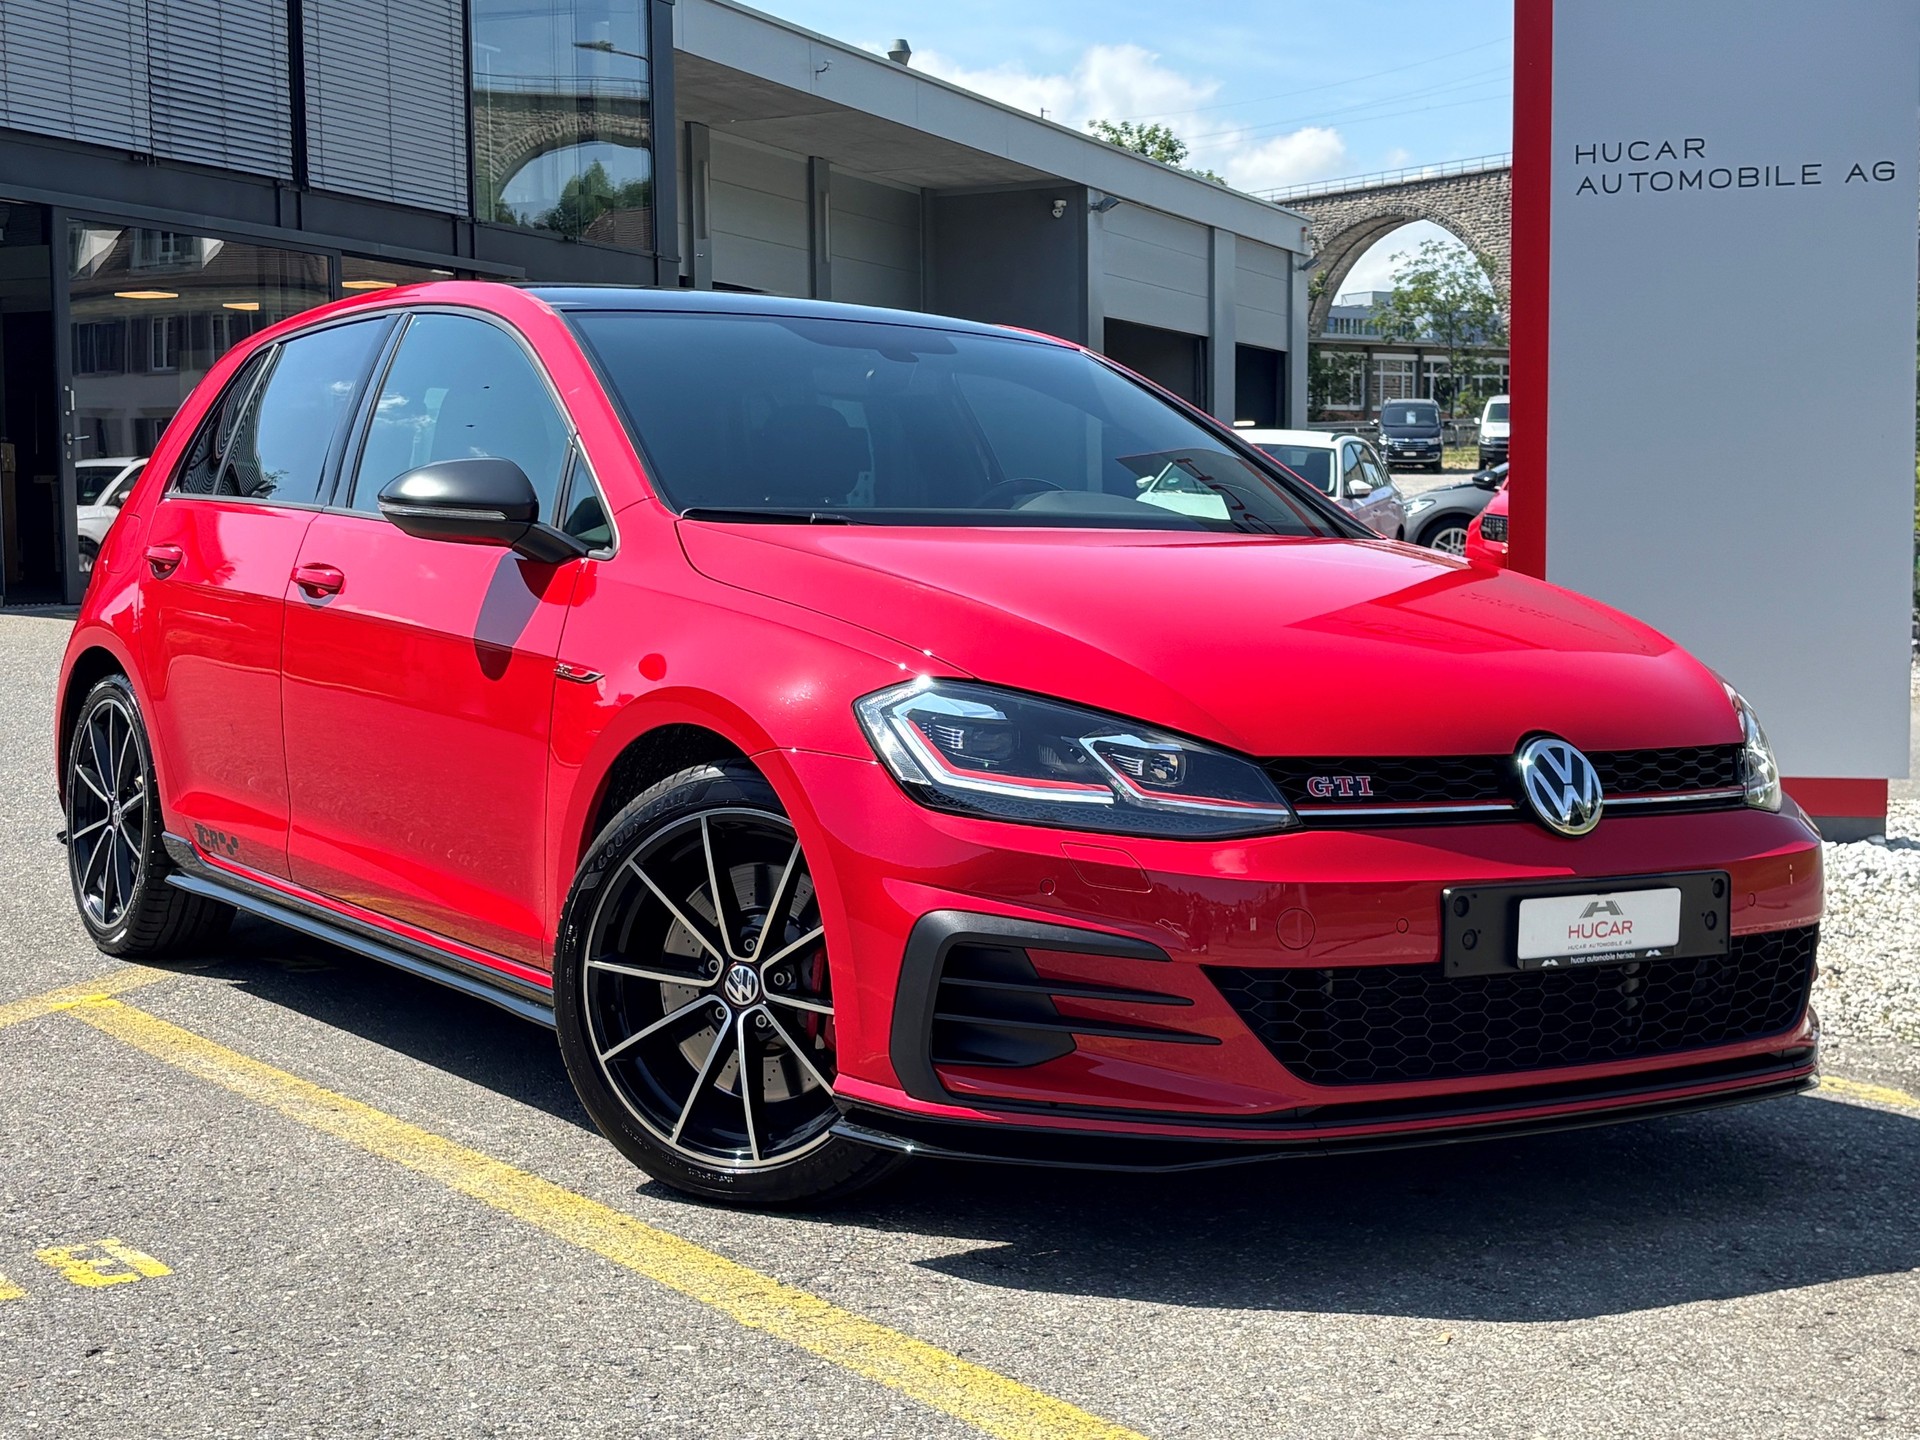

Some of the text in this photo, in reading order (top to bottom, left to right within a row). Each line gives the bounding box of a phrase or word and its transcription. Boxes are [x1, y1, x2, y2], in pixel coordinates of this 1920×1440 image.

[1575, 138, 1706, 165] HUCAR
[1576, 161, 1896, 196] AUTOMOBILE AG
[1306, 776, 1374, 798] GTI
[1522, 737, 1603, 834] VW
[1568, 921, 1632, 939] HUCAR
